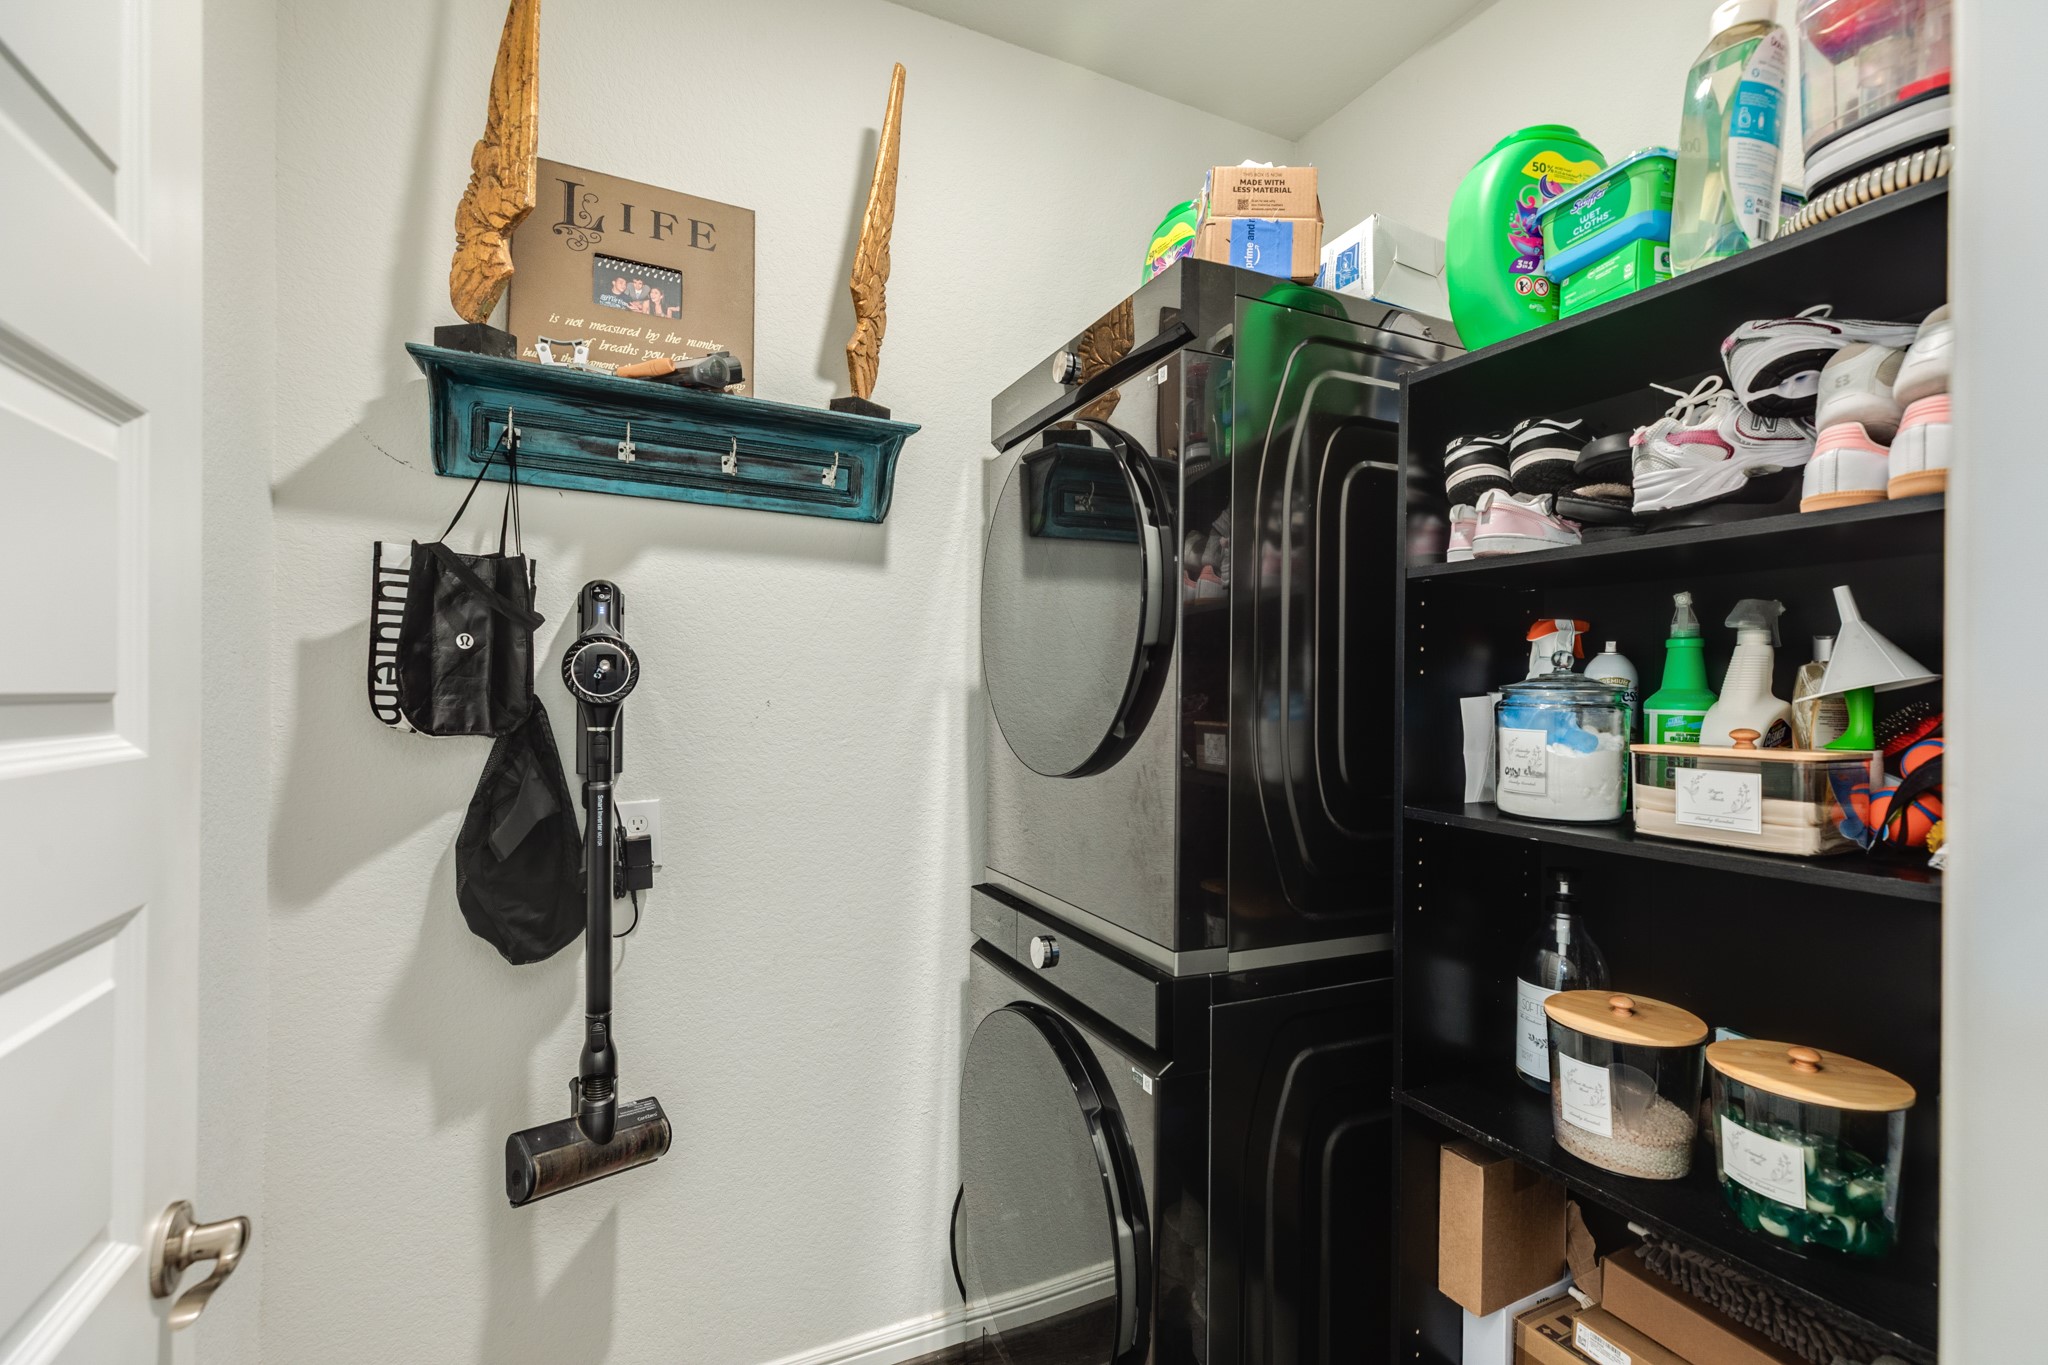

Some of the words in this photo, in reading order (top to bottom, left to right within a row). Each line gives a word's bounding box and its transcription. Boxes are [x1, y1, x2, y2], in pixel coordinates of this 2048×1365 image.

[1532, 161, 1554, 173] 50%
[552, 178, 717, 252] LIFE
[1573, 211, 1610, 236] CLOTHS
[1580, 207, 1601, 224] WET
[1247, 224, 1256, 241] and
[1244, 242, 1254, 269] prime
[549, 313, 559, 323] is
[565, 318, 584, 328] not
[589, 321, 641, 338] measured
[645, 329, 660, 344] by
[665, 332, 682, 344] the
[686, 339, 725, 351] number
[599, 340, 639, 356] breaths
[642, 349, 664, 361] you
[671, 353, 693, 361] tak
[1521, 999, 1547, 1017] SOFTE
